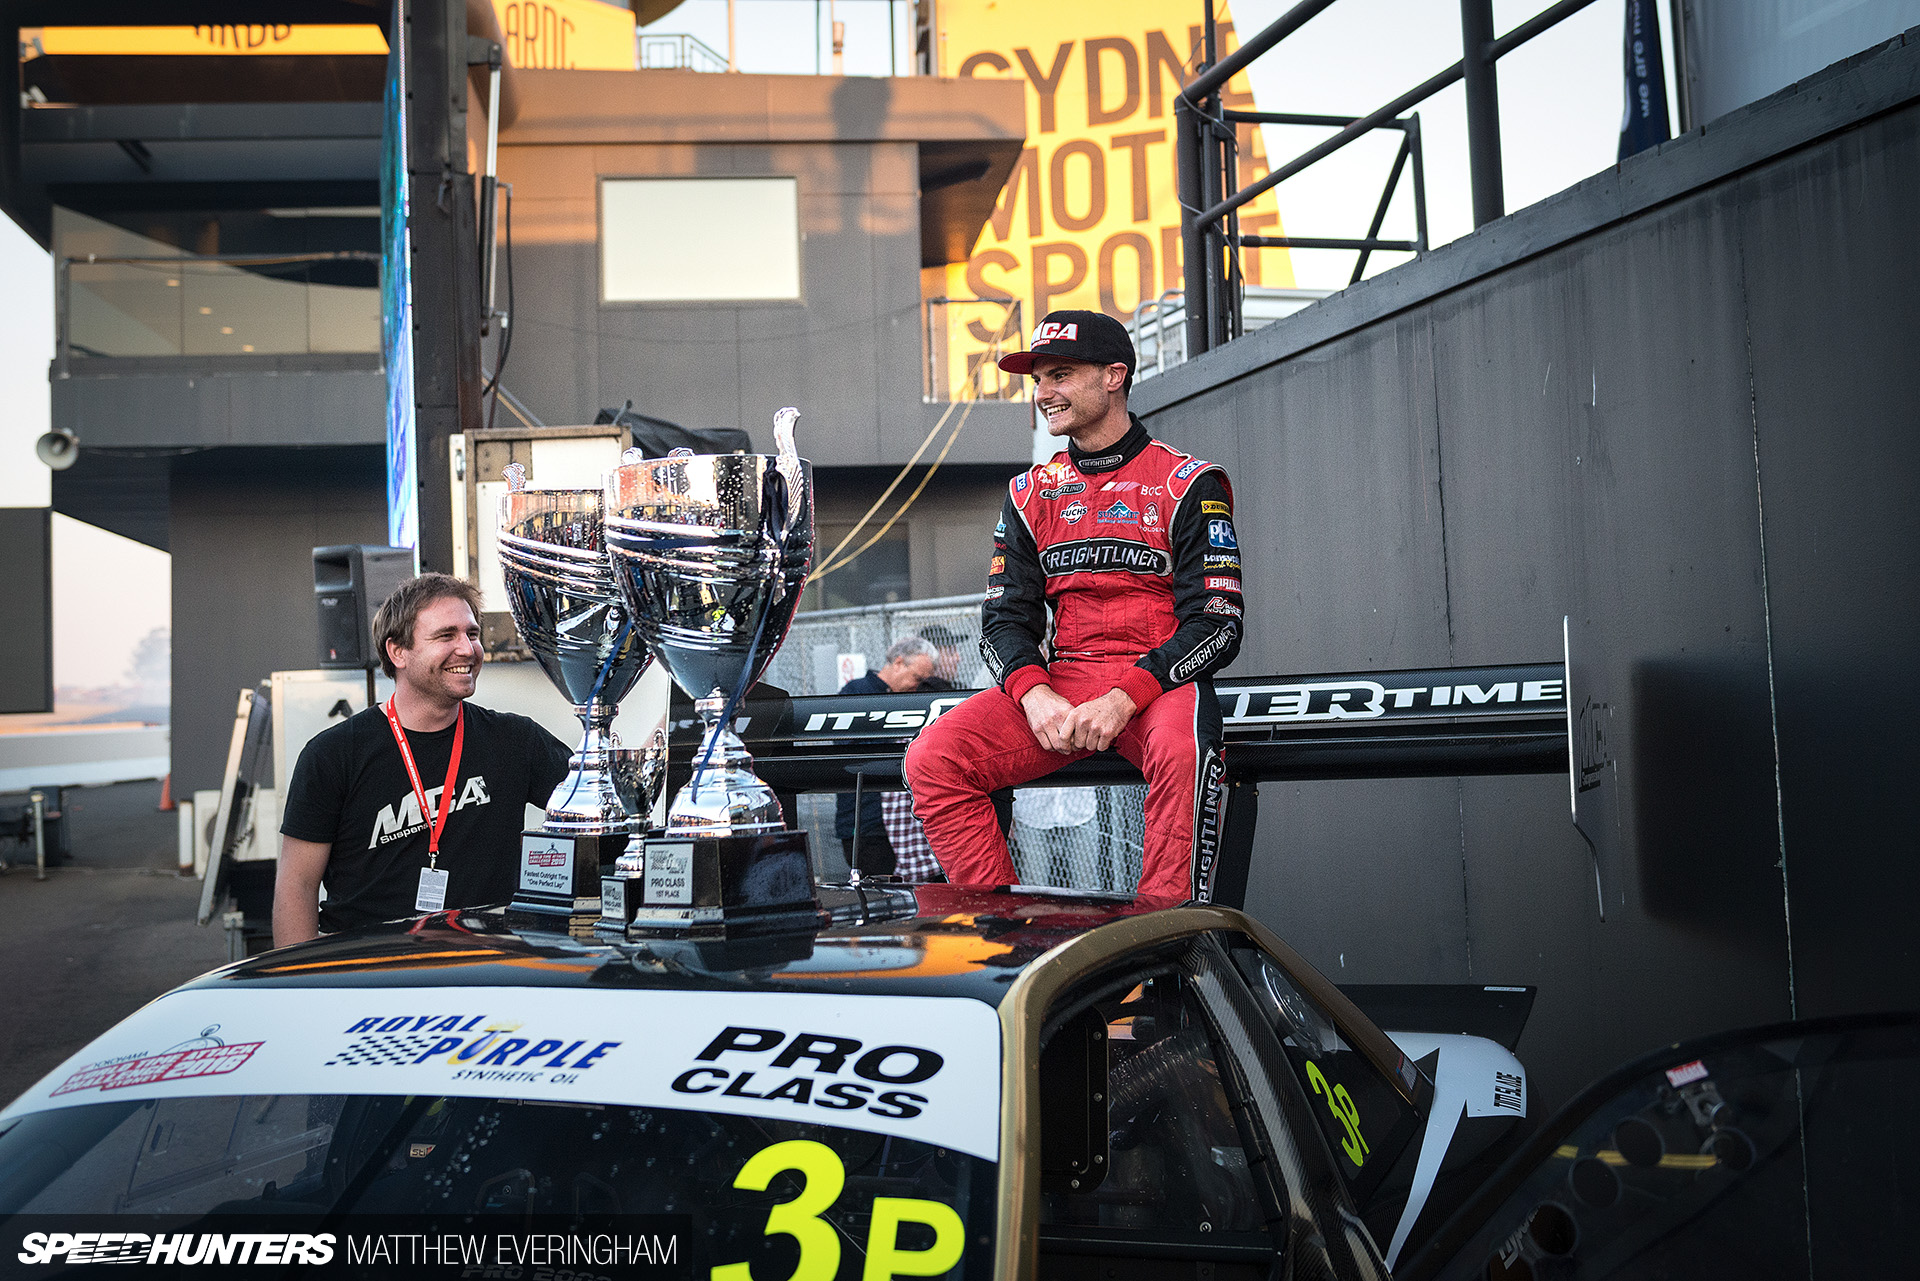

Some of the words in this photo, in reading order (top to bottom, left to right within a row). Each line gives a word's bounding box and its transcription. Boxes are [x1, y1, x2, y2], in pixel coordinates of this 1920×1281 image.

[1633, 40, 1647, 78] are
[1638, 83, 1649, 118] we
[1140, 485, 1163, 496] BOC
[1061, 507, 1087, 517] FUCHS
[1098, 510, 1140, 519] SUMMIT
[1046, 546, 1159, 568] FREIGHTLINER
[1178, 629, 1235, 678] FREIGHTLINER
[804, 710, 927, 731] IT'S
[368, 776, 490, 850] MCA
[1198, 764, 1222, 904] REIGHTLINER
[651, 878, 665, 887] PRO
[665, 878, 685, 888] CLASS
[344, 1015, 487, 1034] ROYAL
[93, 1051, 149, 1069] YOKOHAMA
[136, 1053, 185, 1071] TIME
[181, 1043, 260, 1062] ATTACK
[412, 1031, 624, 1069] PURPLE
[694, 1026, 945, 1084] PRO
[452, 1069, 544, 1083] SYNTHETIC
[550, 1074, 581, 1085] OIL
[671, 1067, 929, 1119] CLASS
[1306, 1060, 1370, 1167] 3P
